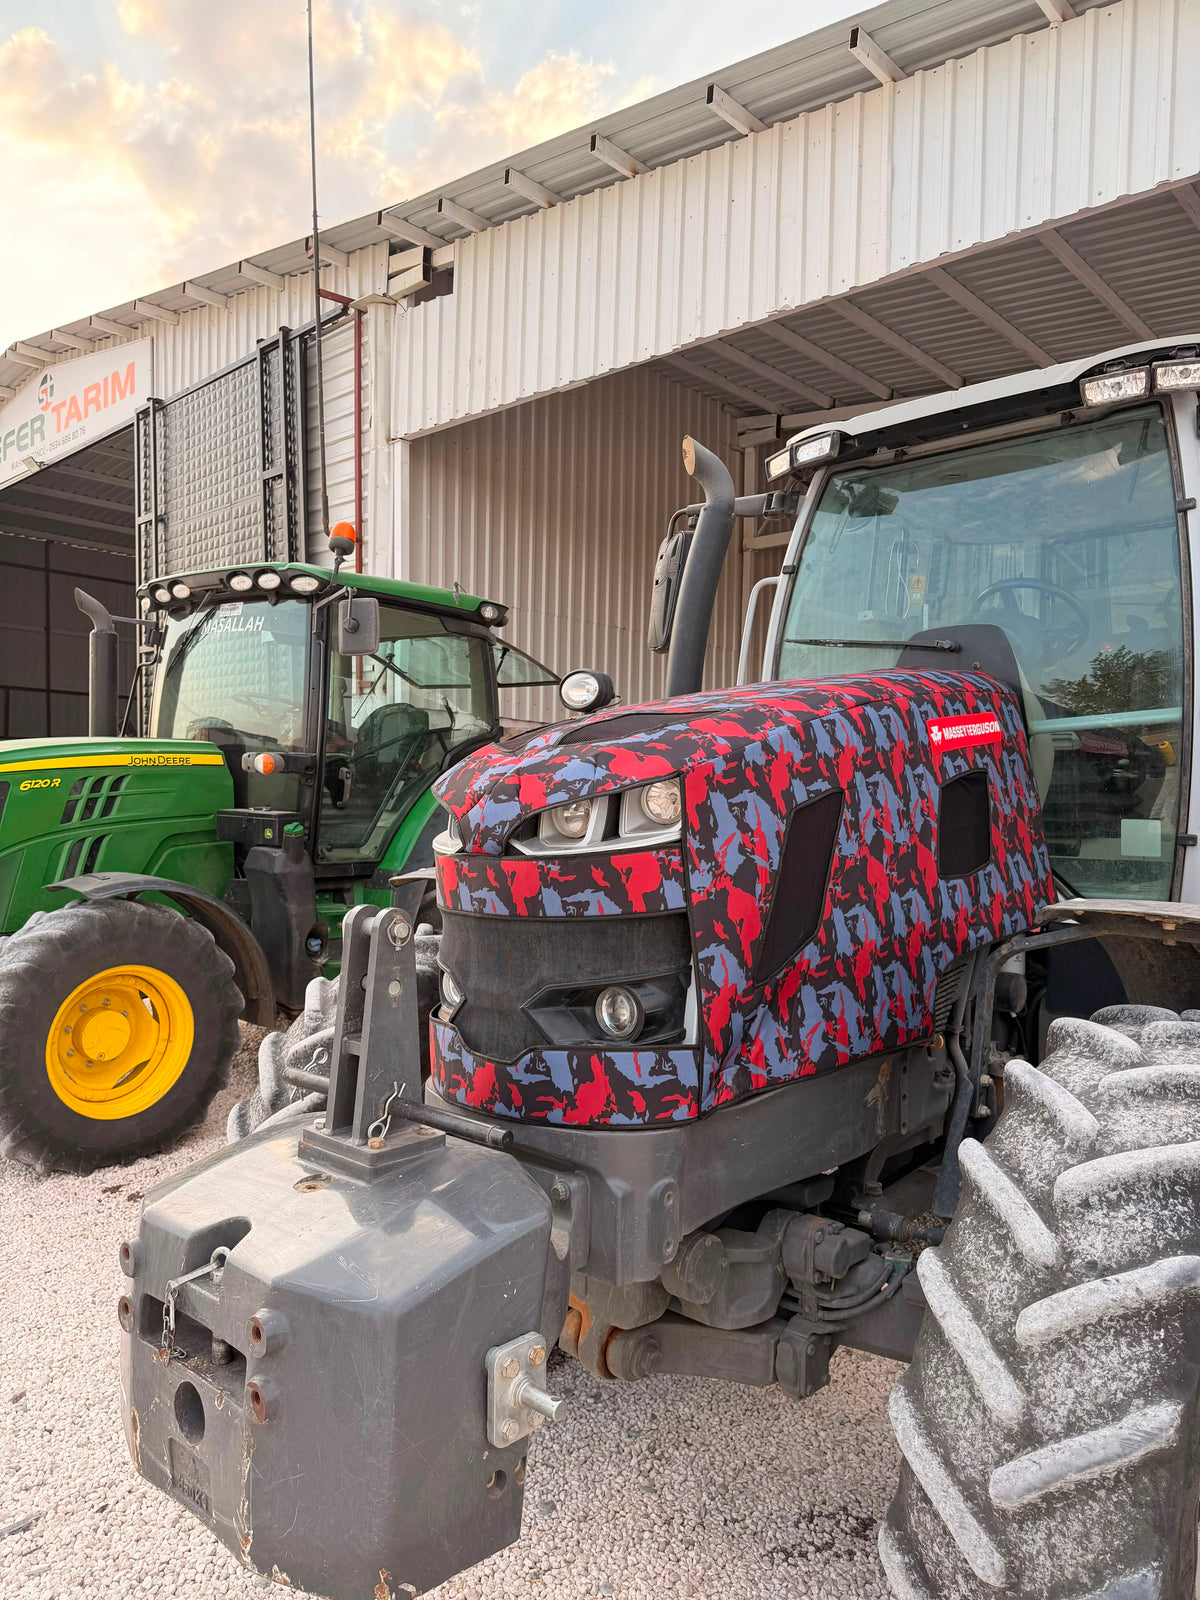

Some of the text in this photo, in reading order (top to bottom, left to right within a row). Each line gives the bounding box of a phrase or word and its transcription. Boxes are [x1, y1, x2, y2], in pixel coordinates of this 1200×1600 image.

[0, 413, 45, 461] FER
[51, 361, 135, 434] TARIM
[128, 755, 192, 766] JOHN DEERE
